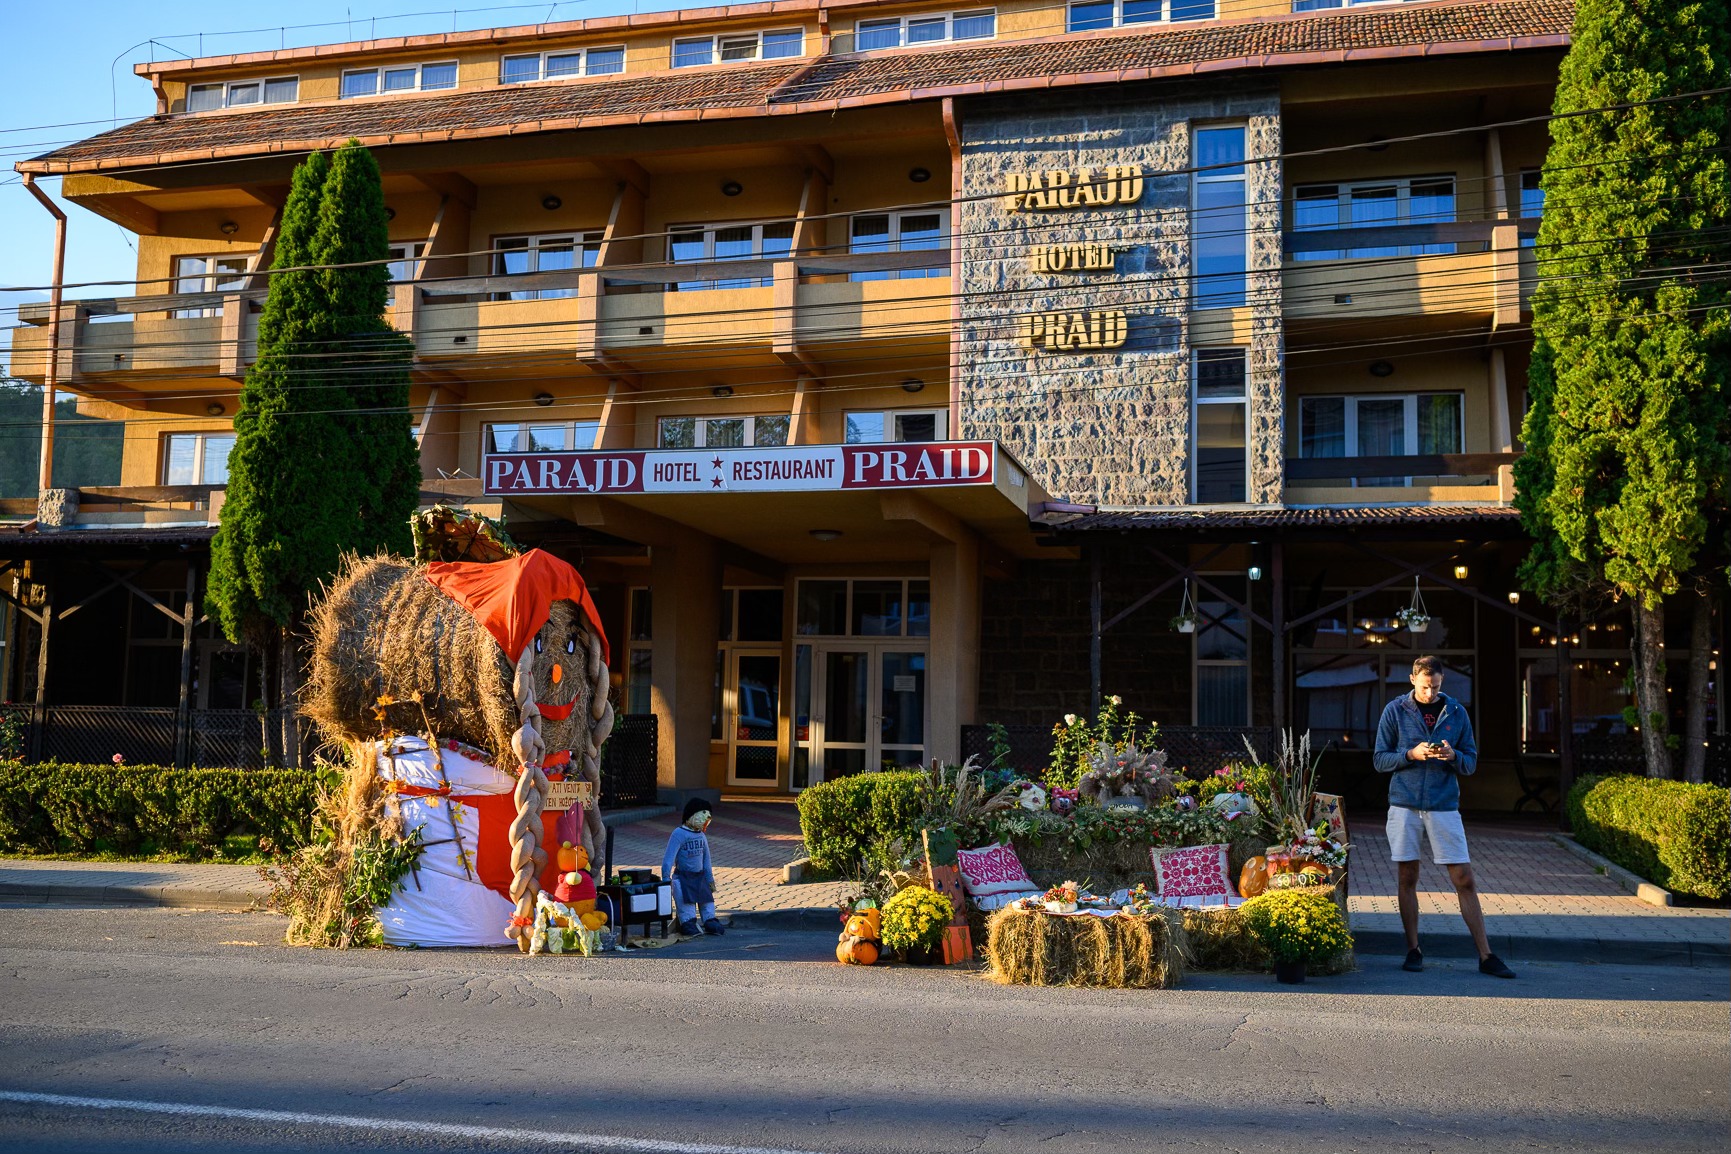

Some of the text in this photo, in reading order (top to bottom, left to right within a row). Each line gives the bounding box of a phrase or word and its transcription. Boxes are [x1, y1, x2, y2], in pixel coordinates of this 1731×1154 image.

[1005, 165, 1144, 212] PARAJD
[1031, 243, 1115, 273] HOTEL
[1020, 310, 1128, 350] PRAID
[488, 447, 989, 492] PARAJD HOTEL RESTAURANT PRAID
